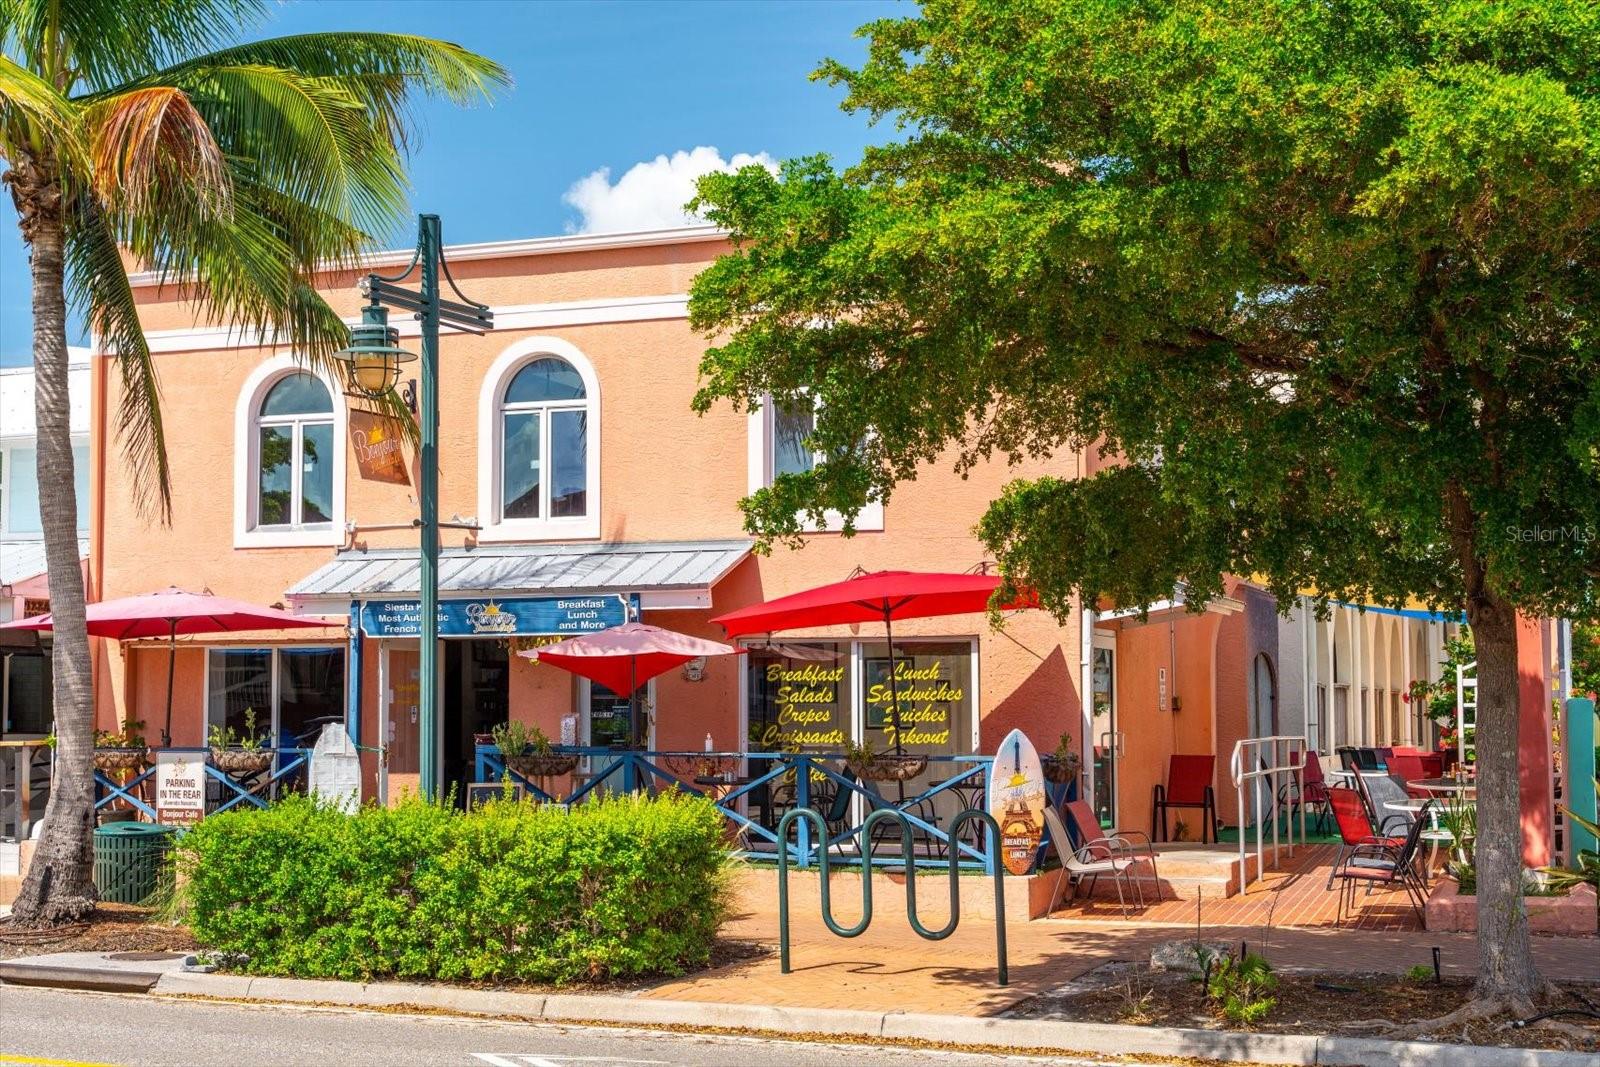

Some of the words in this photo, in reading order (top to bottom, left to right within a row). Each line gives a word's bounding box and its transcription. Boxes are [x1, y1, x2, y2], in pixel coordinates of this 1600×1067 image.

[384, 603, 414, 611] Siesta
[557, 600, 606, 609] Breakfast
[378, 614, 402, 622] Most
[404, 614, 449, 622] Auttic
[567, 611, 598, 619] Lunch
[384, 625, 417, 633] French
[559, 621, 578, 629] and
[580, 620, 606, 630] More
[766, 664, 844, 687] Breakfast
[887, 661, 940, 680] Lunch
[774, 686, 834, 703] Salads
[866, 682, 963, 703] Sandwiches
[778, 704, 832, 727] Crepes
[761, 725, 845, 746] Croissants
[883, 726, 949, 745] Takeout
[165, 778, 196, 788] PARKING
[159, 789, 167, 799] IN
[168, 789, 181, 799] THE
[182, 789, 201, 799] REAR
[162, 809, 184, 819] Bonjour
[1010, 850, 1027, 858] LUNCH
